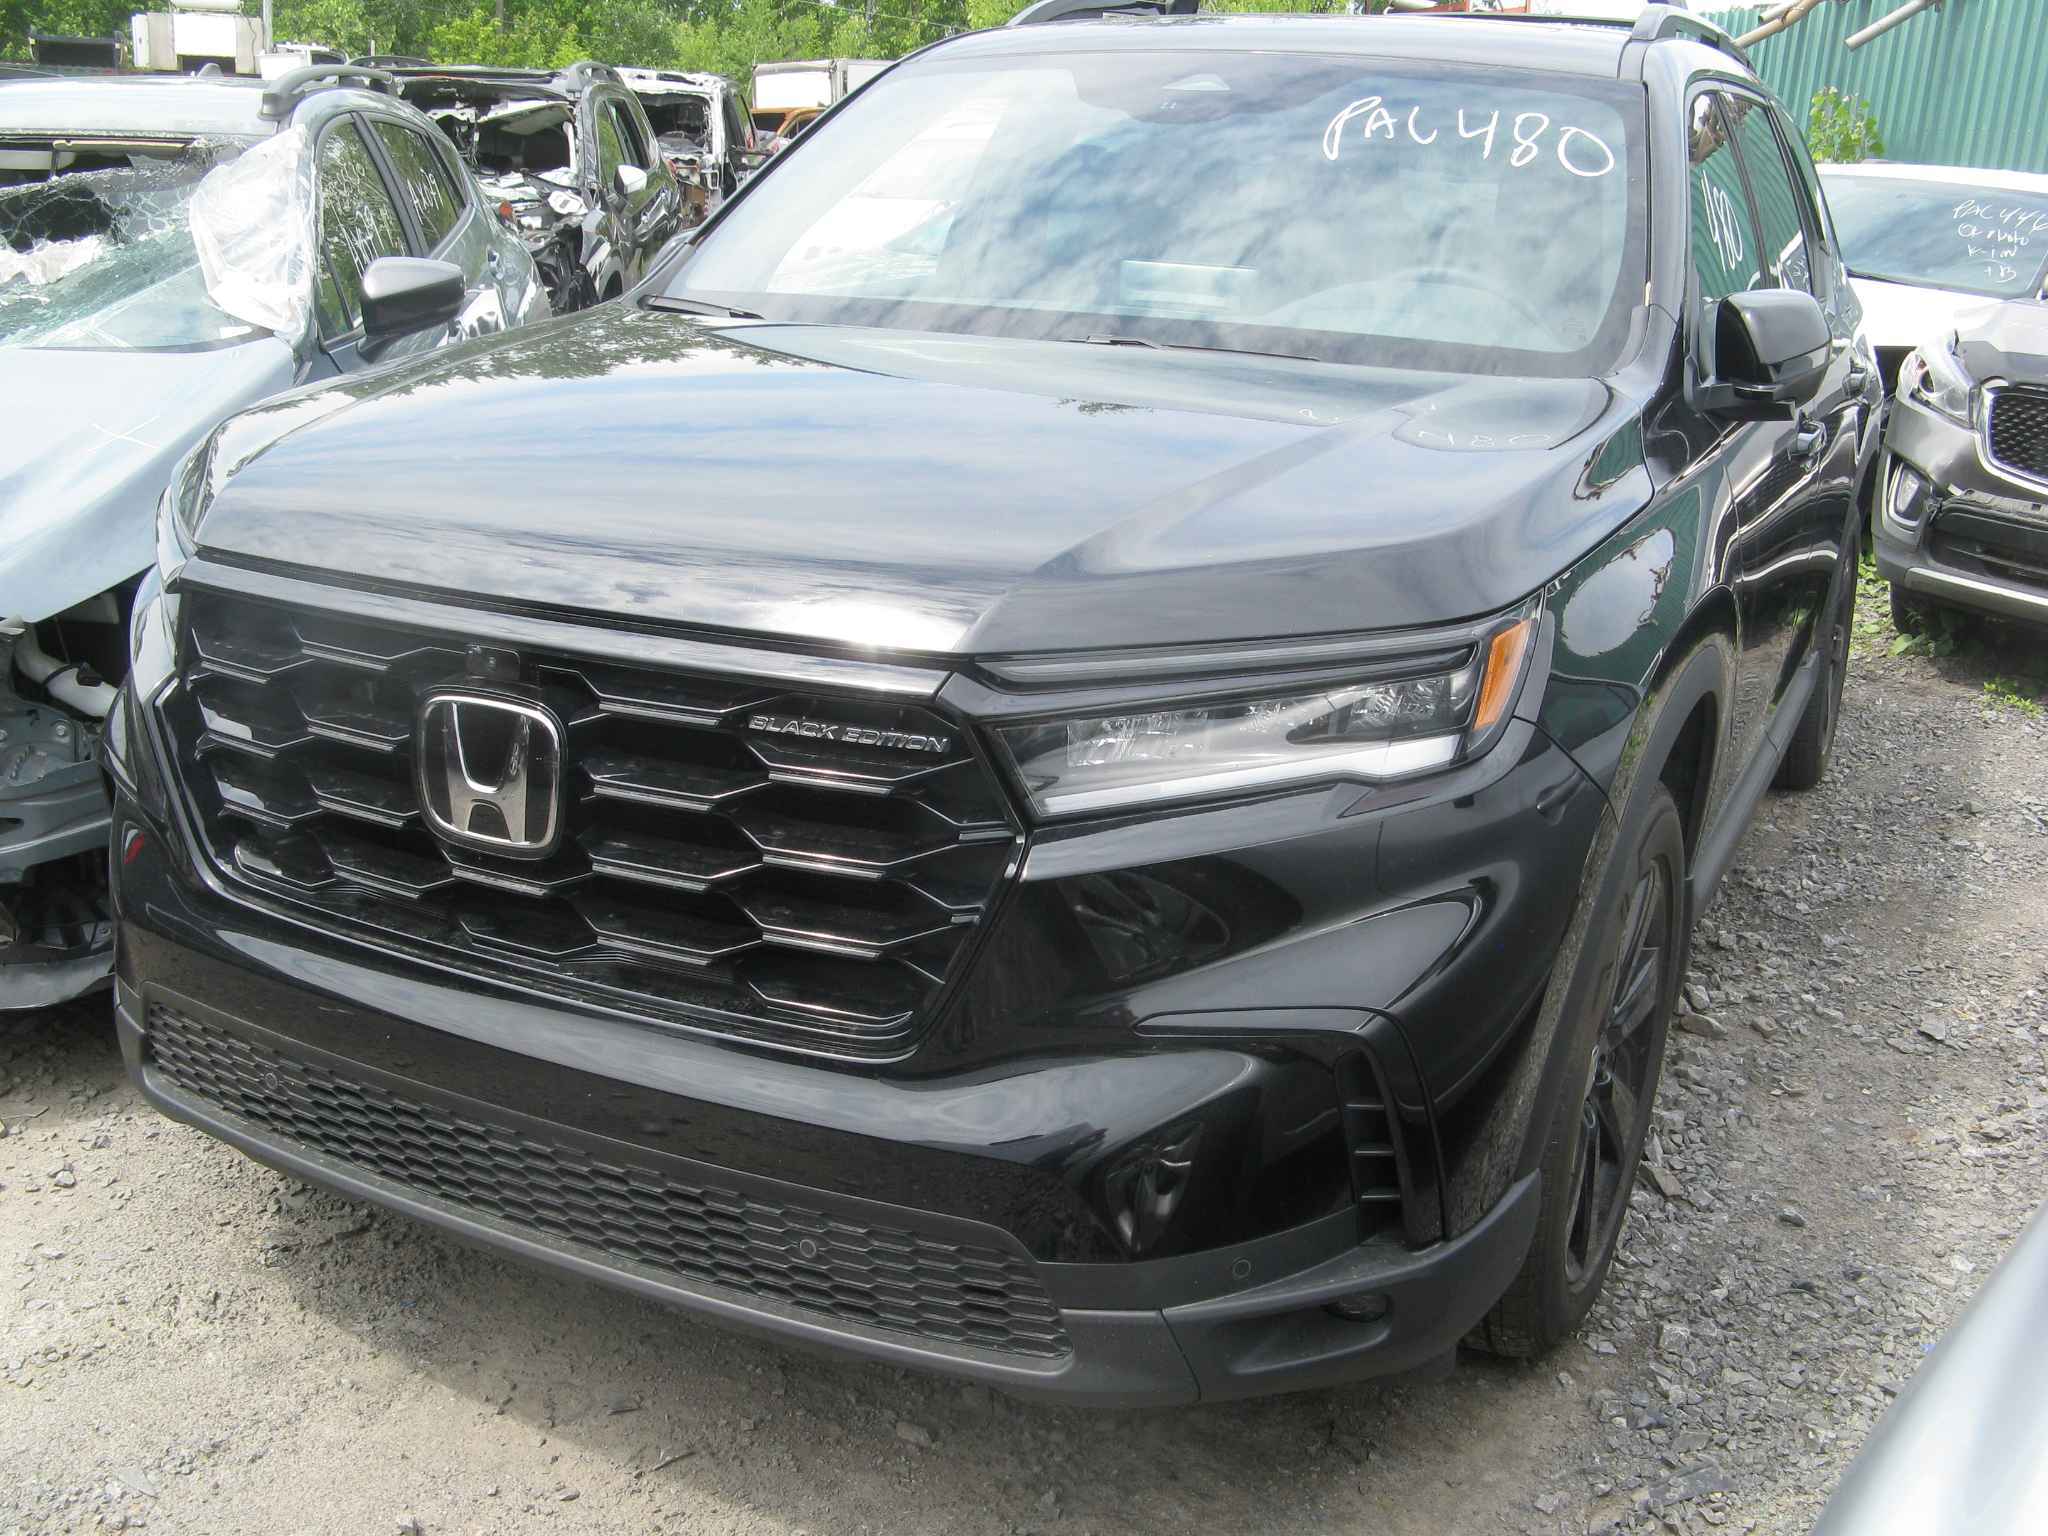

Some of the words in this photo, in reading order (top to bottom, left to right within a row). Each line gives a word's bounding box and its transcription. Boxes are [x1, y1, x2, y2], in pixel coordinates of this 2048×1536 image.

[1323, 95, 1438, 160] PAC
[1457, 109, 1615, 177] 480
[1700, 168, 1743, 275] 480
[749, 715, 839, 740] BLACK
[841, 727, 948, 752] EDITION
